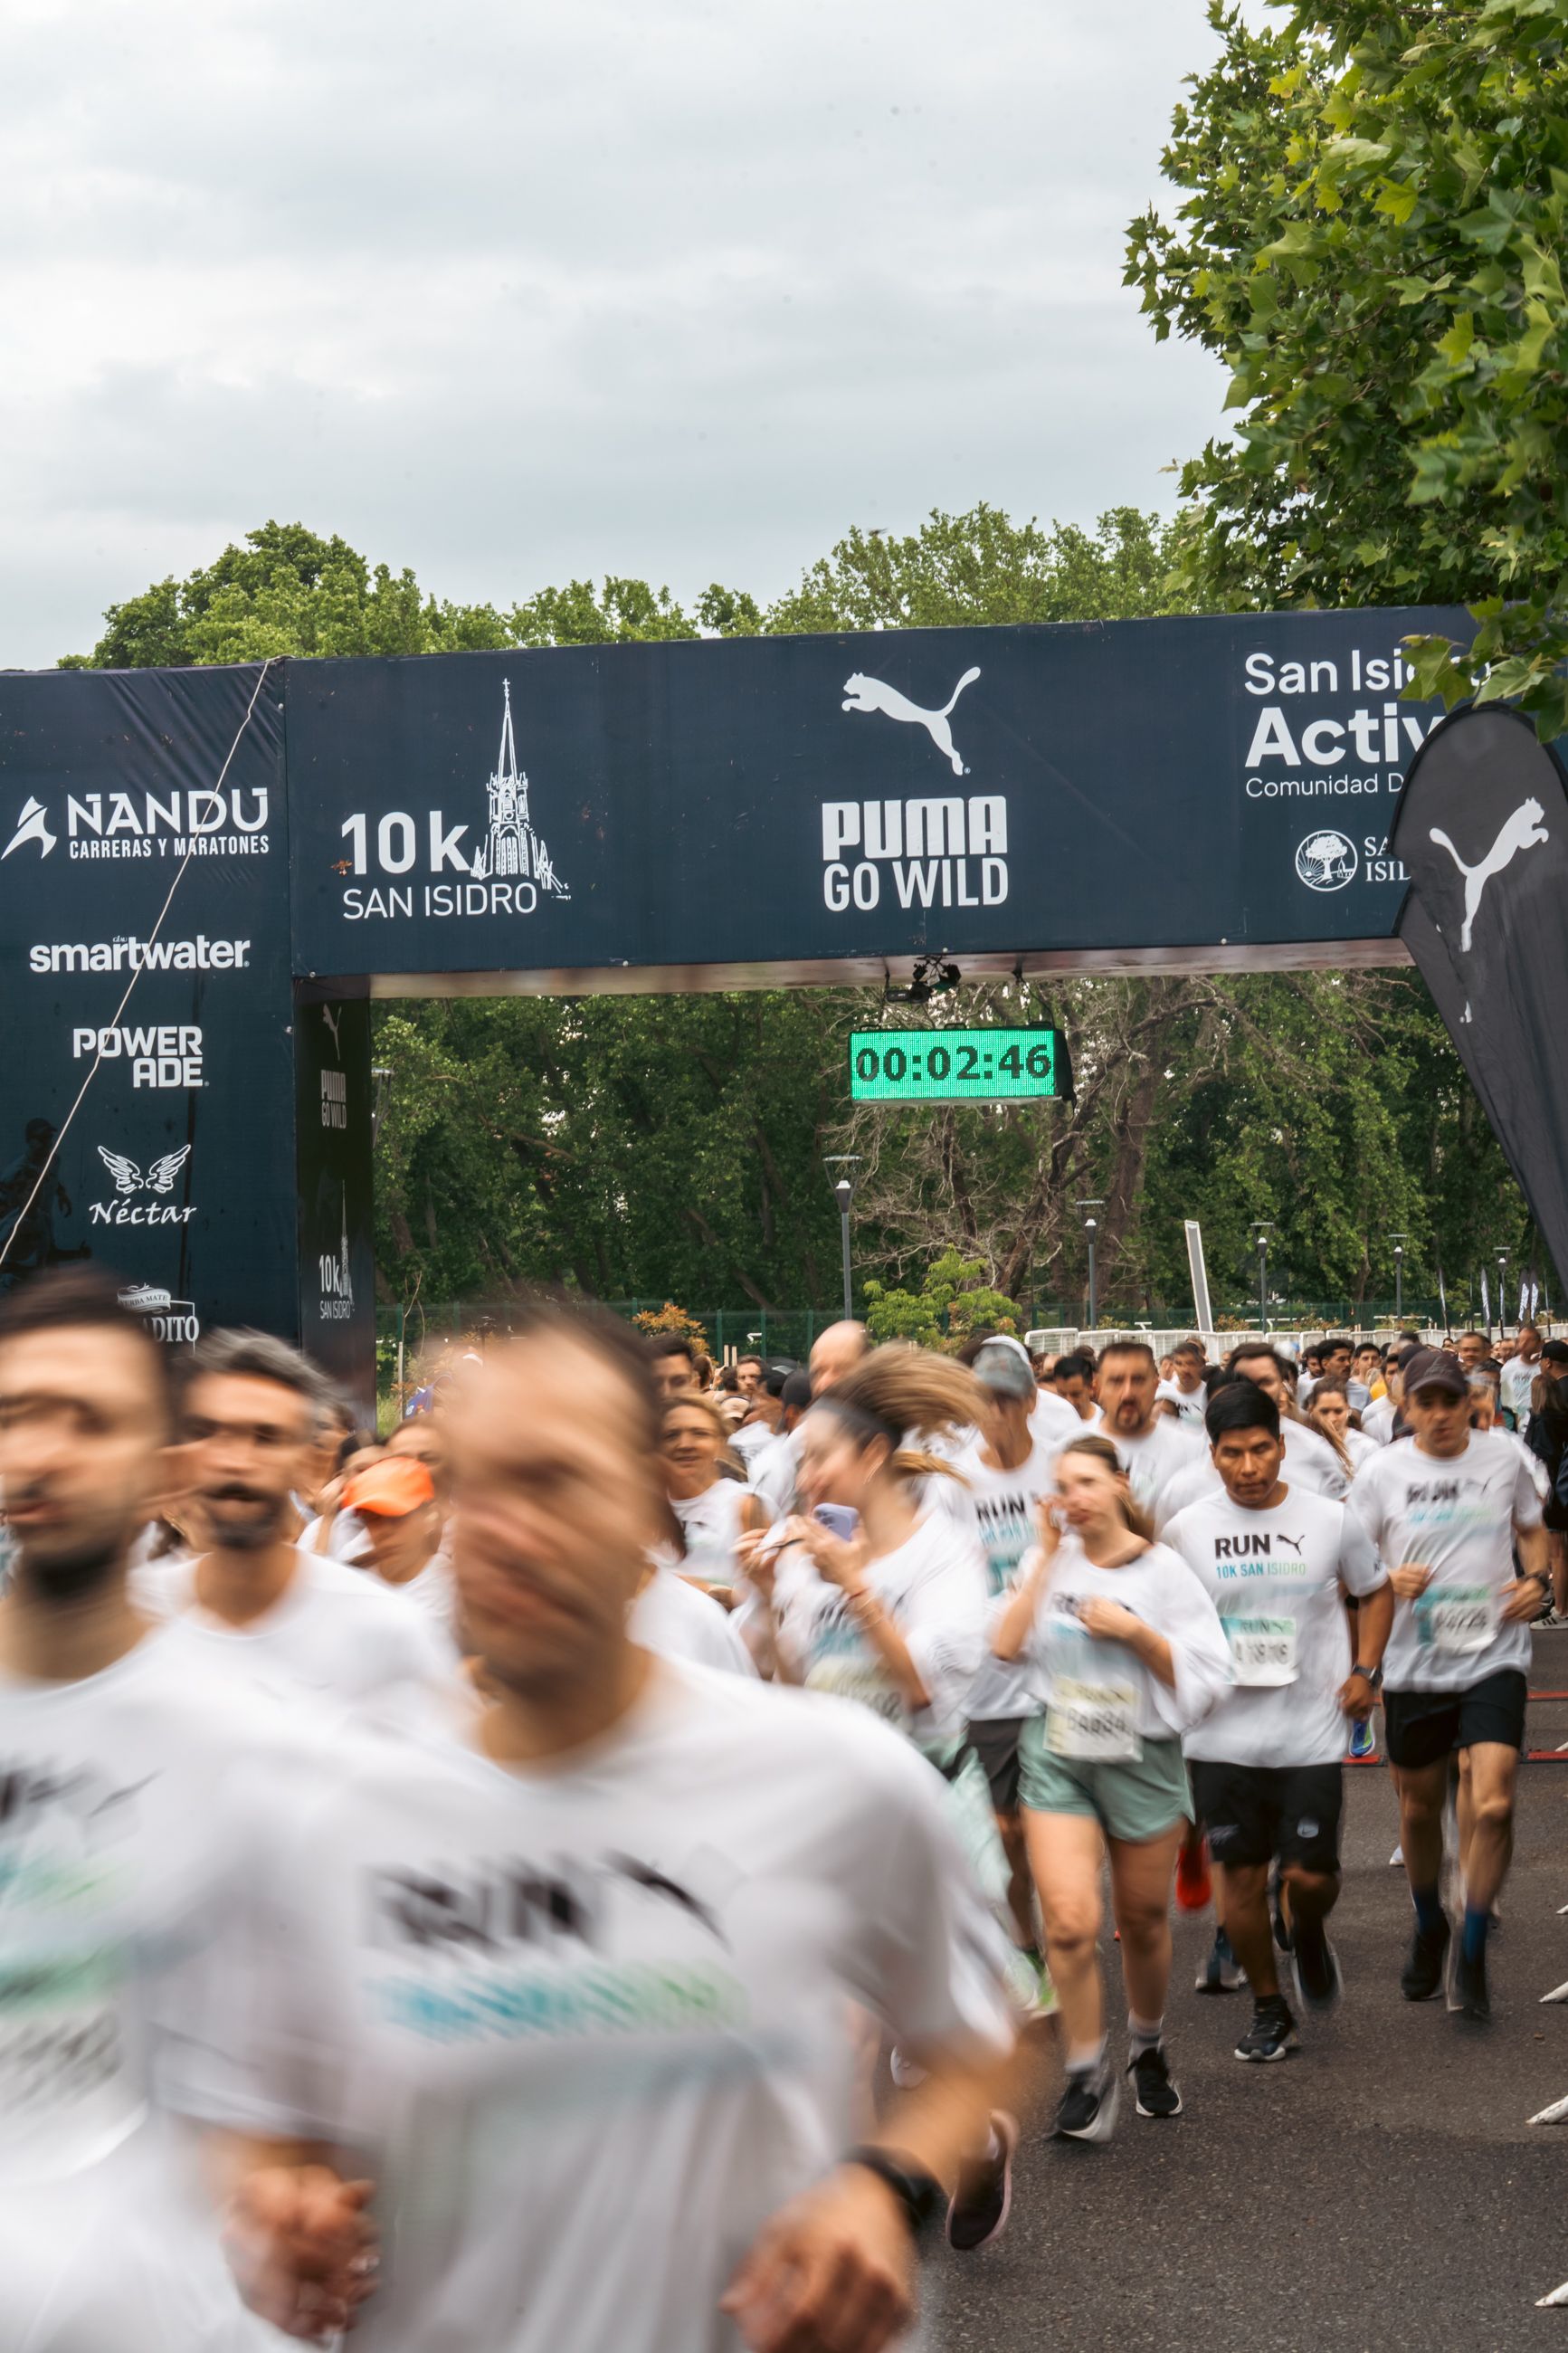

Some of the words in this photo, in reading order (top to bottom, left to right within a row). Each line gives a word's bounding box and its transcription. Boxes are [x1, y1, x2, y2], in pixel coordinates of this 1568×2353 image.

[1244, 653, 1338, 695] San
[1245, 773, 1379, 798] Comunidad
[822, 795, 1008, 861] PUMA
[70, 838, 152, 859] CARRERAS
[158, 838, 167, 856] Y
[174, 834, 270, 856] MARATONES
[343, 886, 413, 919] SAN
[425, 881, 537, 917] ISIDRO
[822, 862, 879, 912] GO
[892, 857, 1009, 909] WILD
[29, 935, 250, 972] smartwater
[73, 1026, 204, 1057] POWER
[133, 1057, 204, 1088] ADE
[856, 1043, 1052, 1082] 00:02:46
[89, 1198, 197, 1225] Néctar
[146, 1294, 168, 1302] MATE
[319, 1300, 332, 1319] SAN
[1214, 1534, 1271, 1559] RUN
[1216, 1566, 1237, 1579] 10K
[1240, 1563, 1264, 1577] SAN
[1267, 1562, 1307, 1576] ISIDRO
